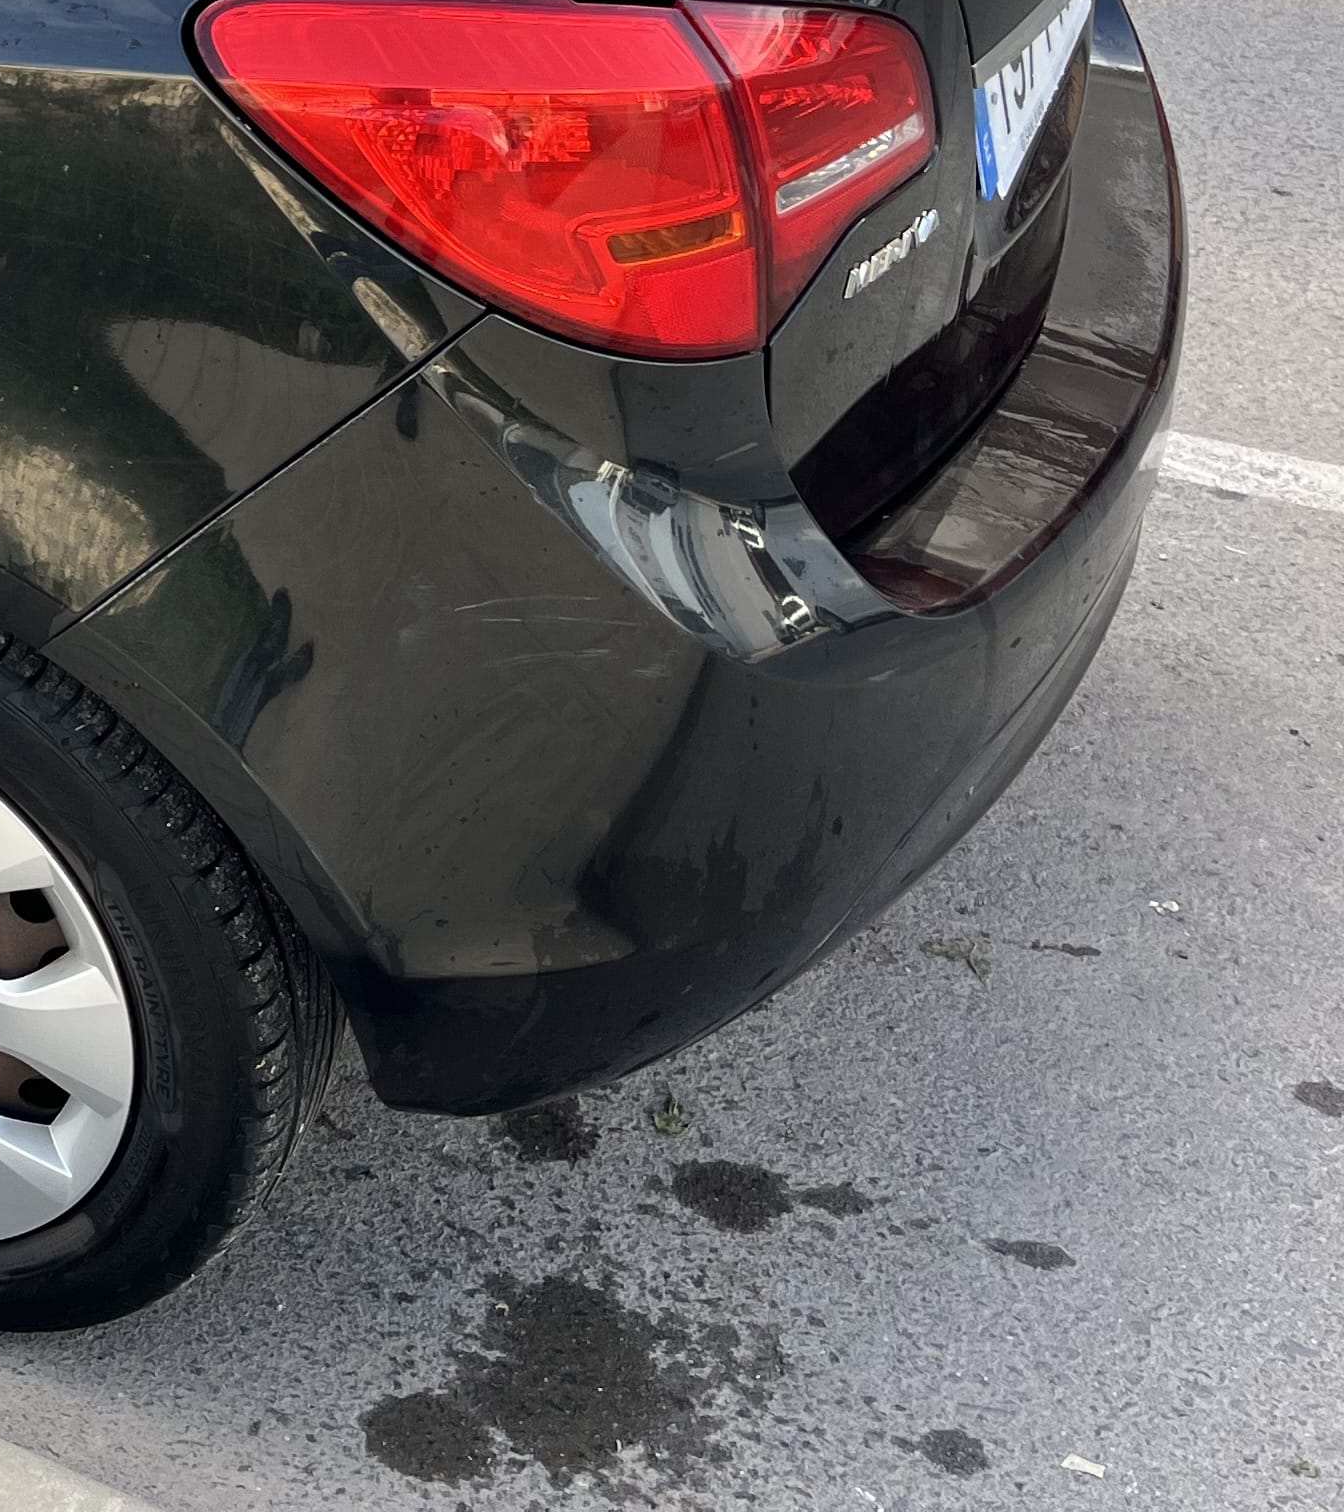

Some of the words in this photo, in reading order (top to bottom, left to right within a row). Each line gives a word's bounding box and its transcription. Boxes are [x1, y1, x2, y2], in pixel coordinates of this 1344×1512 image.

[108, 903, 138, 947] THE
[133, 956, 162, 1017] RAIN
[154, 1039, 171, 1100] TYRE
